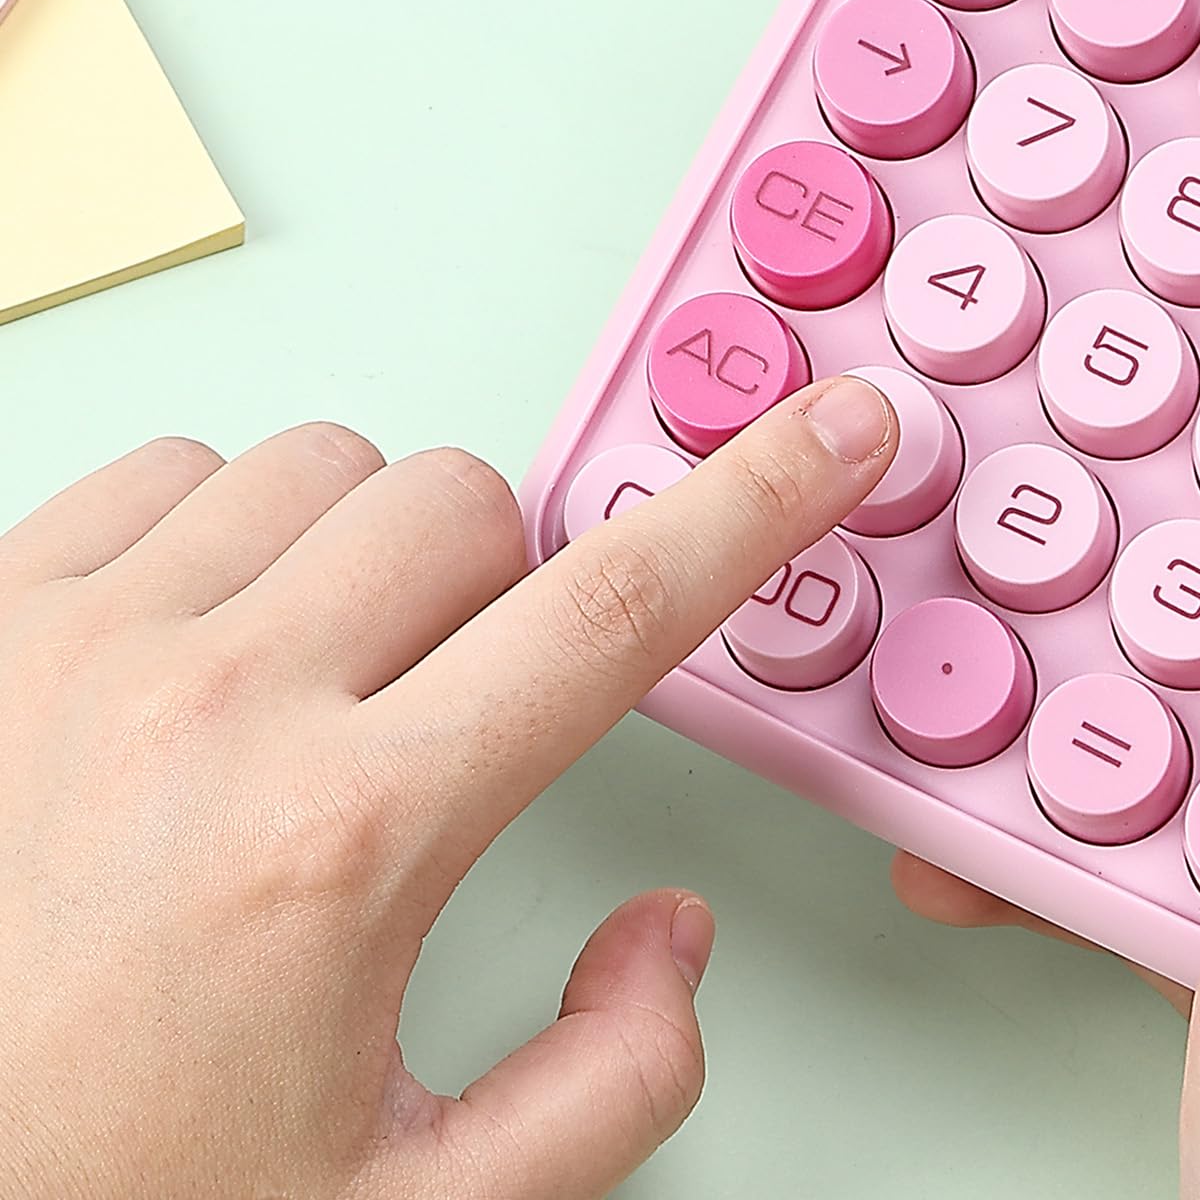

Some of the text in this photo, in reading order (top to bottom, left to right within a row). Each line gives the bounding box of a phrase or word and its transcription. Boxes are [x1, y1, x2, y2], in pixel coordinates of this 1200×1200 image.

[1016, 96, 1077, 148] 7
[754, 170, 855, 243] CE
[927, 264, 987, 311] 4
[665, 328, 770, 396] AC
[1083, 324, 1150, 387] 5
[996, 483, 1063, 547] 2
